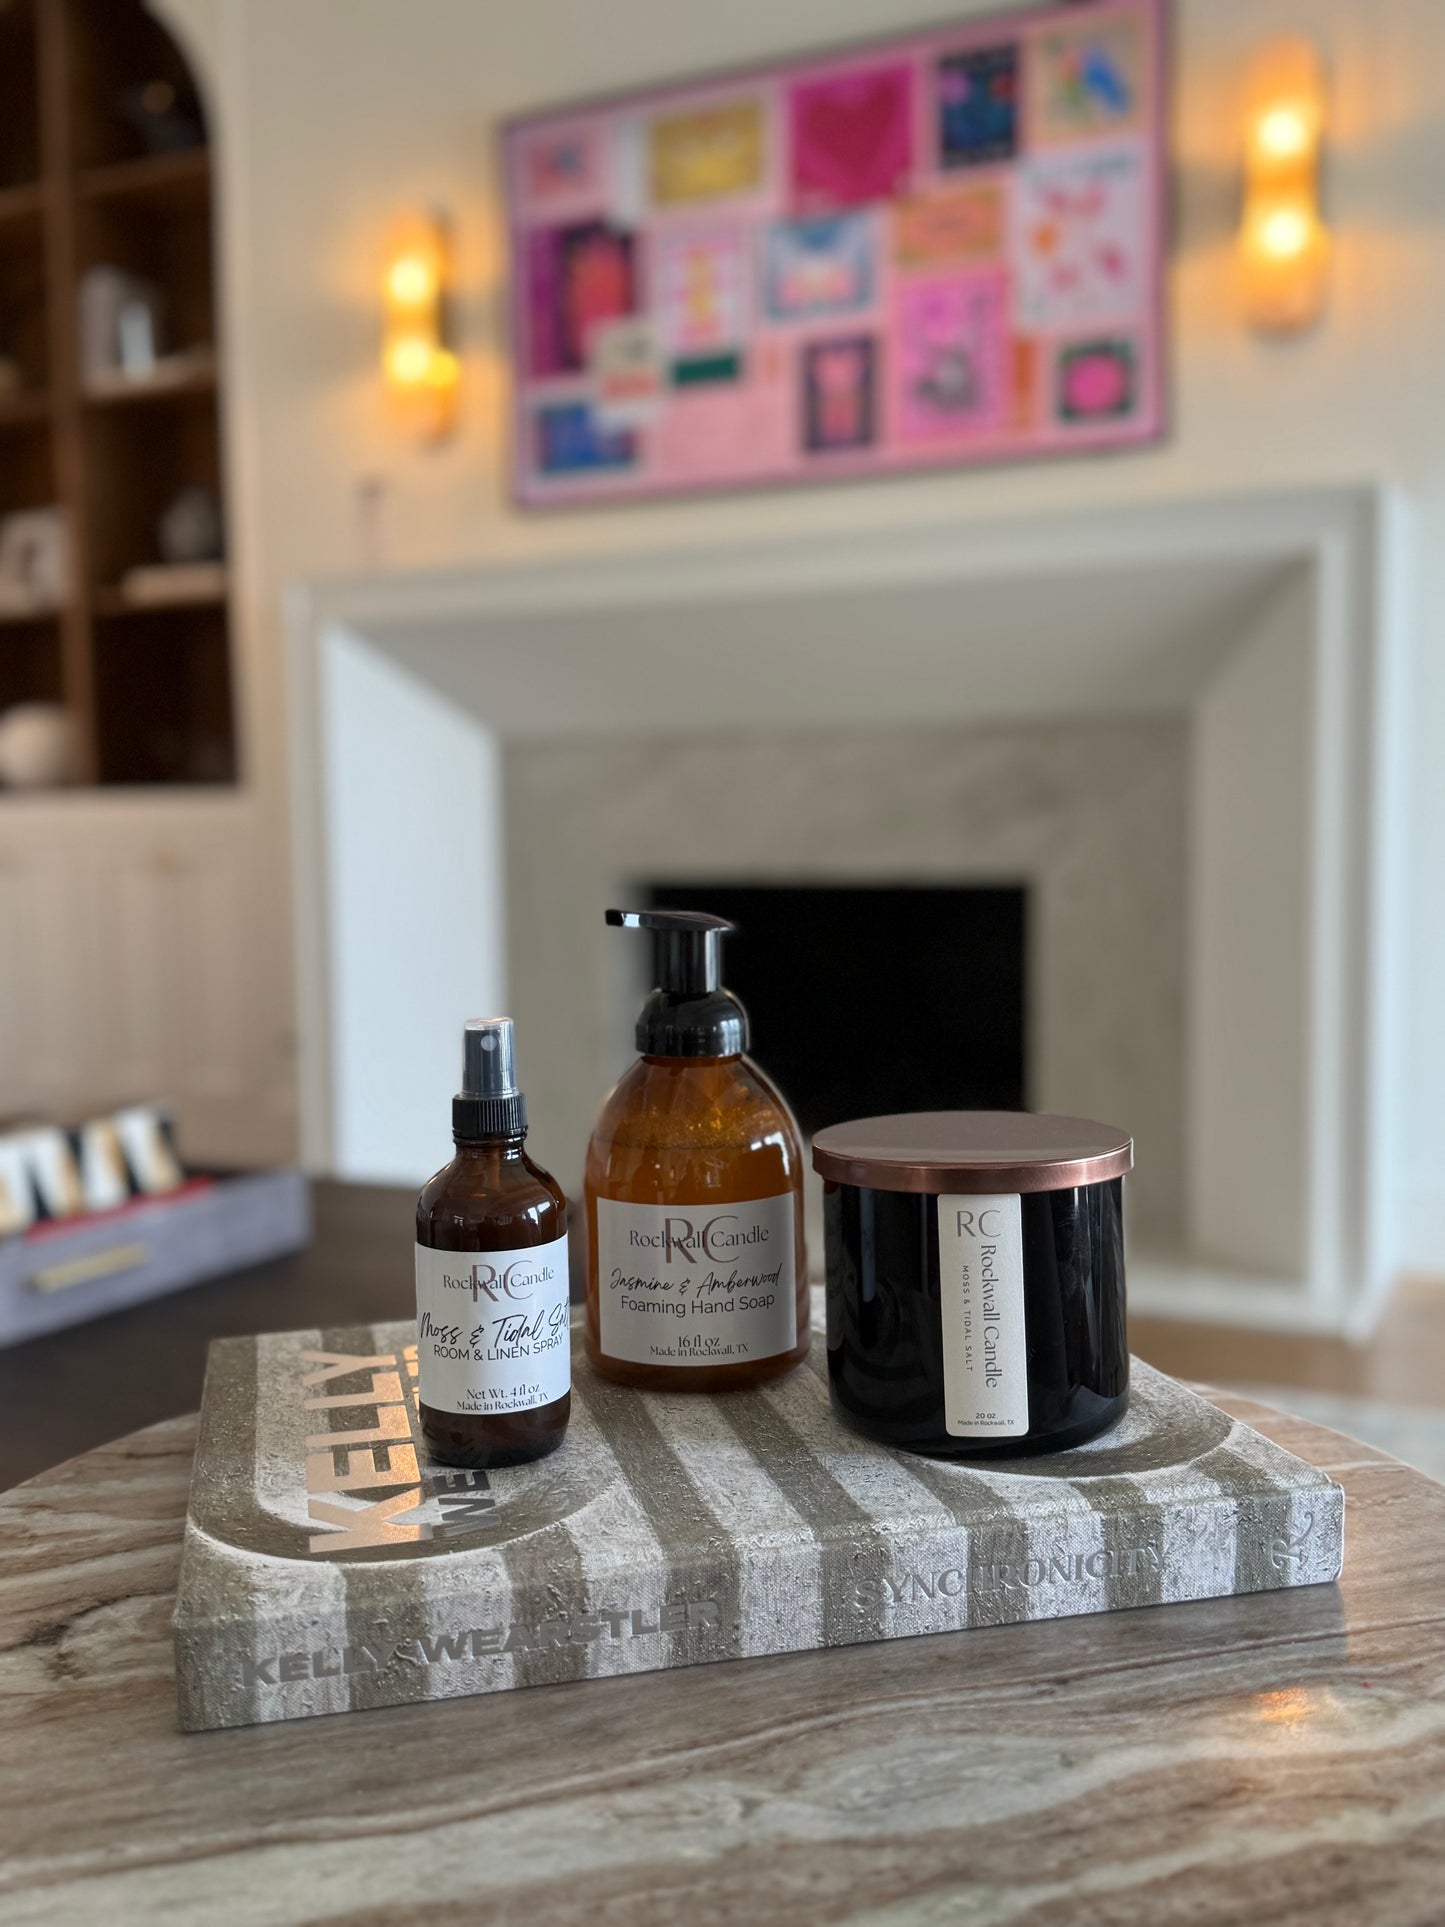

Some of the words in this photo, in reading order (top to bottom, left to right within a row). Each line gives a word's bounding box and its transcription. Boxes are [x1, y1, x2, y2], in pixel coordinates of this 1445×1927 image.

[629, 1230, 705, 1248] Rockwall
[711, 1225, 770, 1248] Candle
[956, 1210, 1002, 1238] RC
[665, 1215, 740, 1264] RC
[443, 1274, 506, 1290] Rockwall
[510, 1266, 554, 1288] Candle
[472, 1260, 534, 1303] RC
[609, 1267, 675, 1292] Jasmine
[678, 1277, 692, 1296] &
[696, 1262, 783, 1299] Amberwood
[962, 1265, 971, 1294] MOSS
[981, 1244, 1001, 1321] Rockwall
[621, 1296, 686, 1318] Foaming
[691, 1297, 735, 1314] Hand
[739, 1293, 775, 1310] Soap
[420, 1312, 464, 1344] Moss
[469, 1324, 485, 1348] &
[492, 1309, 545, 1348] Tidal
[964, 1310, 973, 1340] TIDAL
[433, 1344, 469, 1361] ROOM
[473, 1348, 484, 1361] &
[487, 1344, 530, 1360] LINEN
[532, 1332, 564, 1354] SPRAY
[650, 1346, 676, 1357] Made
[677, 1347, 687, 1357] in
[736, 1343, 749, 1353] TX
[678, 1335, 691, 1348] 16
[693, 1334, 701, 1348] fl
[704, 1337, 721, 1348] oz
[965, 1346, 974, 1372] SALT
[983, 1326, 1003, 1388] Candle
[456, 1400, 482, 1411] Made
[483, 1401, 493, 1411] in
[538, 1392, 549, 1402] TX
[466, 1388, 486, 1400] Net
[488, 1388, 508, 1399] Wt.
[510, 1387, 517, 1397] 4
[528, 1384, 540, 1394] oz
[300, 1351, 434, 1553] KELLY
[854, 1545, 1167, 1608] SYNCHRONICITY
[241, 1643, 398, 1688] KELLY
[415, 1601, 721, 1664] WEARSTLER
